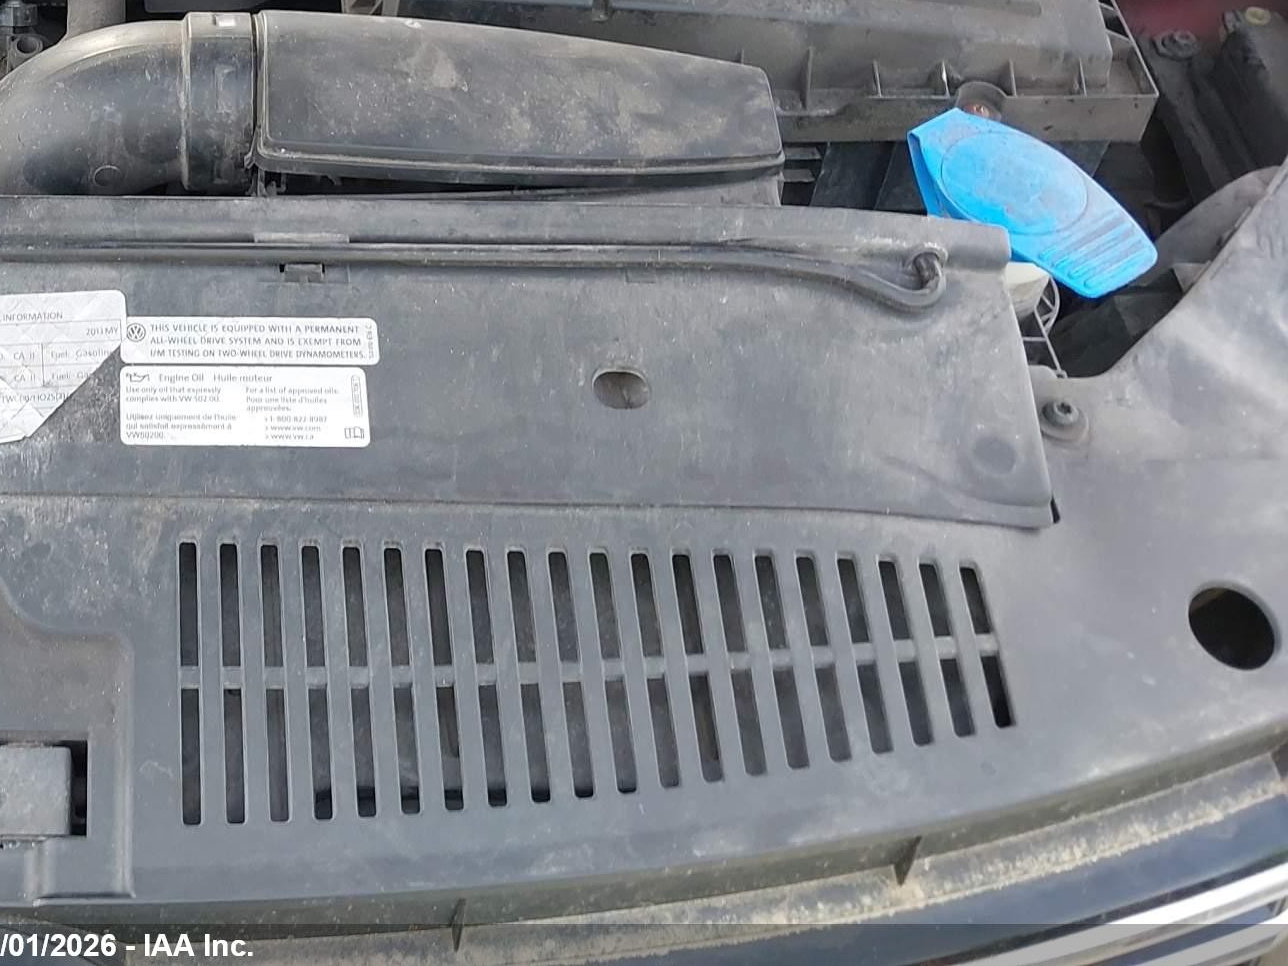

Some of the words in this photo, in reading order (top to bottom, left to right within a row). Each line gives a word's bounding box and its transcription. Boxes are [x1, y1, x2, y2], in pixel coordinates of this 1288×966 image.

[2, 313, 63, 322] INFORMATION
[150, 324, 170, 333] THIS
[172, 324, 208, 333] VEHICLE
[221, 325, 265, 333] EQUIPPED
[268, 325, 292, 333] WITH
[295, 325, 302, 333] A
[304, 325, 359, 334] PERMANENT
[150, 336, 198, 345] ALL-WHEEL
[200, 336, 226, 345] DRIVE
[228, 337, 262, 345] SYSTEM
[265, 337, 285, 345] AND
[287, 337, 295, 345] IS
[298, 338, 332, 346] EXEMPT
[335, 338, 361, 346] FROM
[13, 352, 26, 360] CA
[150, 349, 166, 357] I/M
[167, 349, 200, 357] TESTING
[205, 349, 215, 357] ON
[218, 349, 267, 358] TWO-WHEEL
[269, 350, 292, 358] DRIVE
[295, 350, 367, 359] DYNAMOMETERS.
[159, 373, 190, 384] Engine
[192, 373, 204, 382] Oil
[213, 373, 237, 382] Huile
[239, 375, 273, 383] moteur
[142, 386, 158, 395] only
[125, 395, 159, 404] complies
[246, 395, 263, 403] Pour
